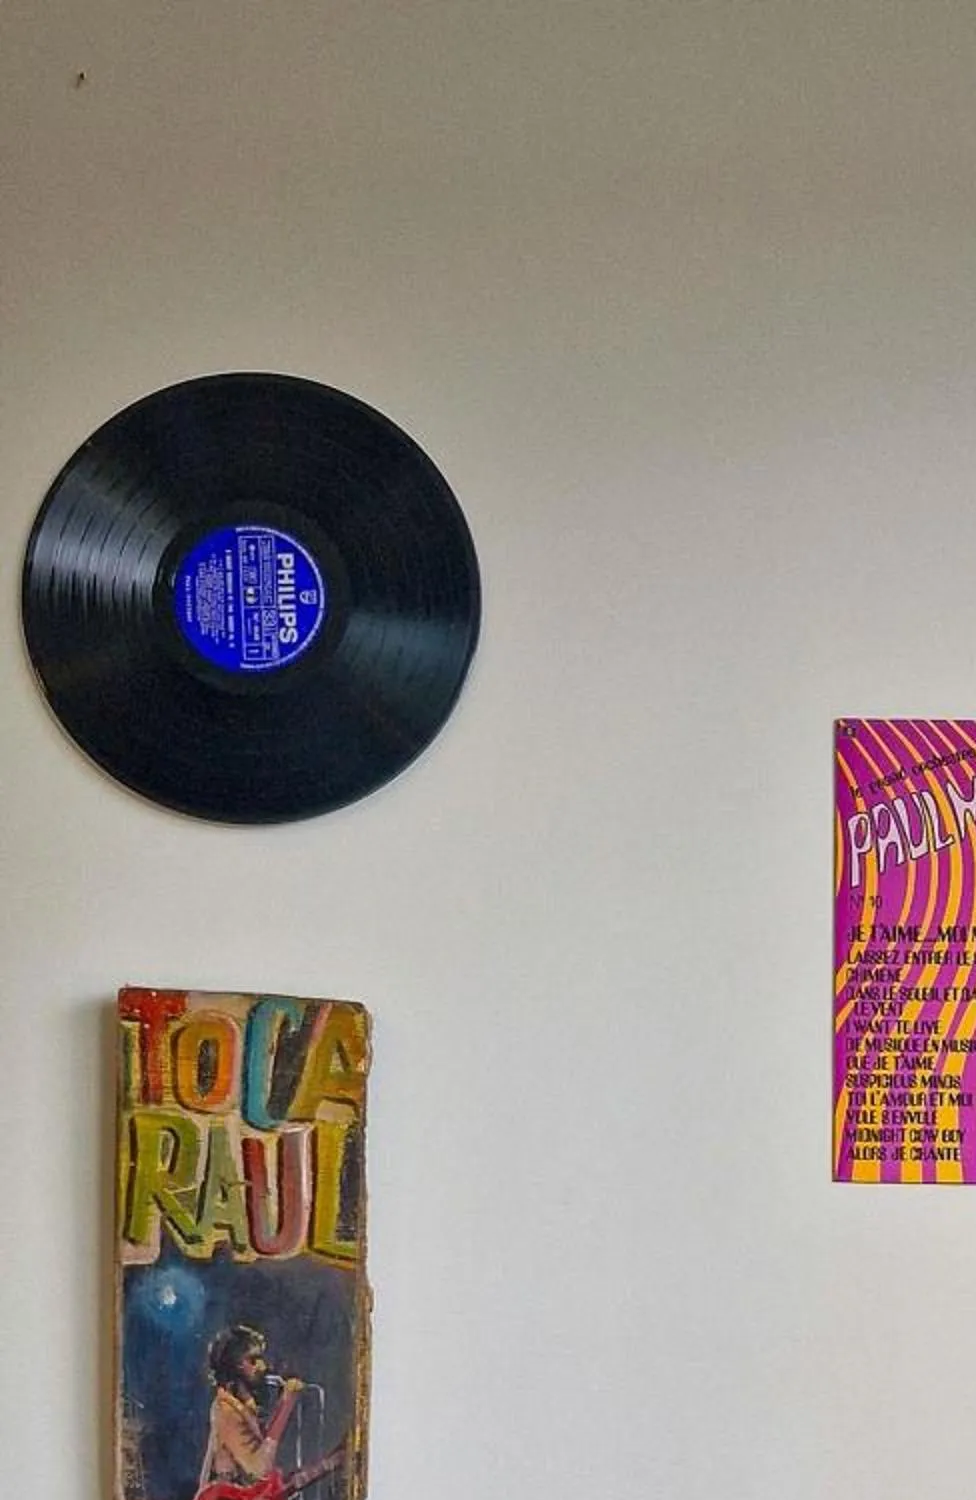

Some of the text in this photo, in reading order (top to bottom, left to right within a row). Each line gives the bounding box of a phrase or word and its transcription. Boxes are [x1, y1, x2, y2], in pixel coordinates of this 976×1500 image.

[277, 553, 298, 643] PHILIPS
[847, 791, 954, 888] PAUL
[848, 925, 865, 942] JE
[118, 984, 372, 1132] TOCA
[123, 1112, 362, 1260] RAUL
